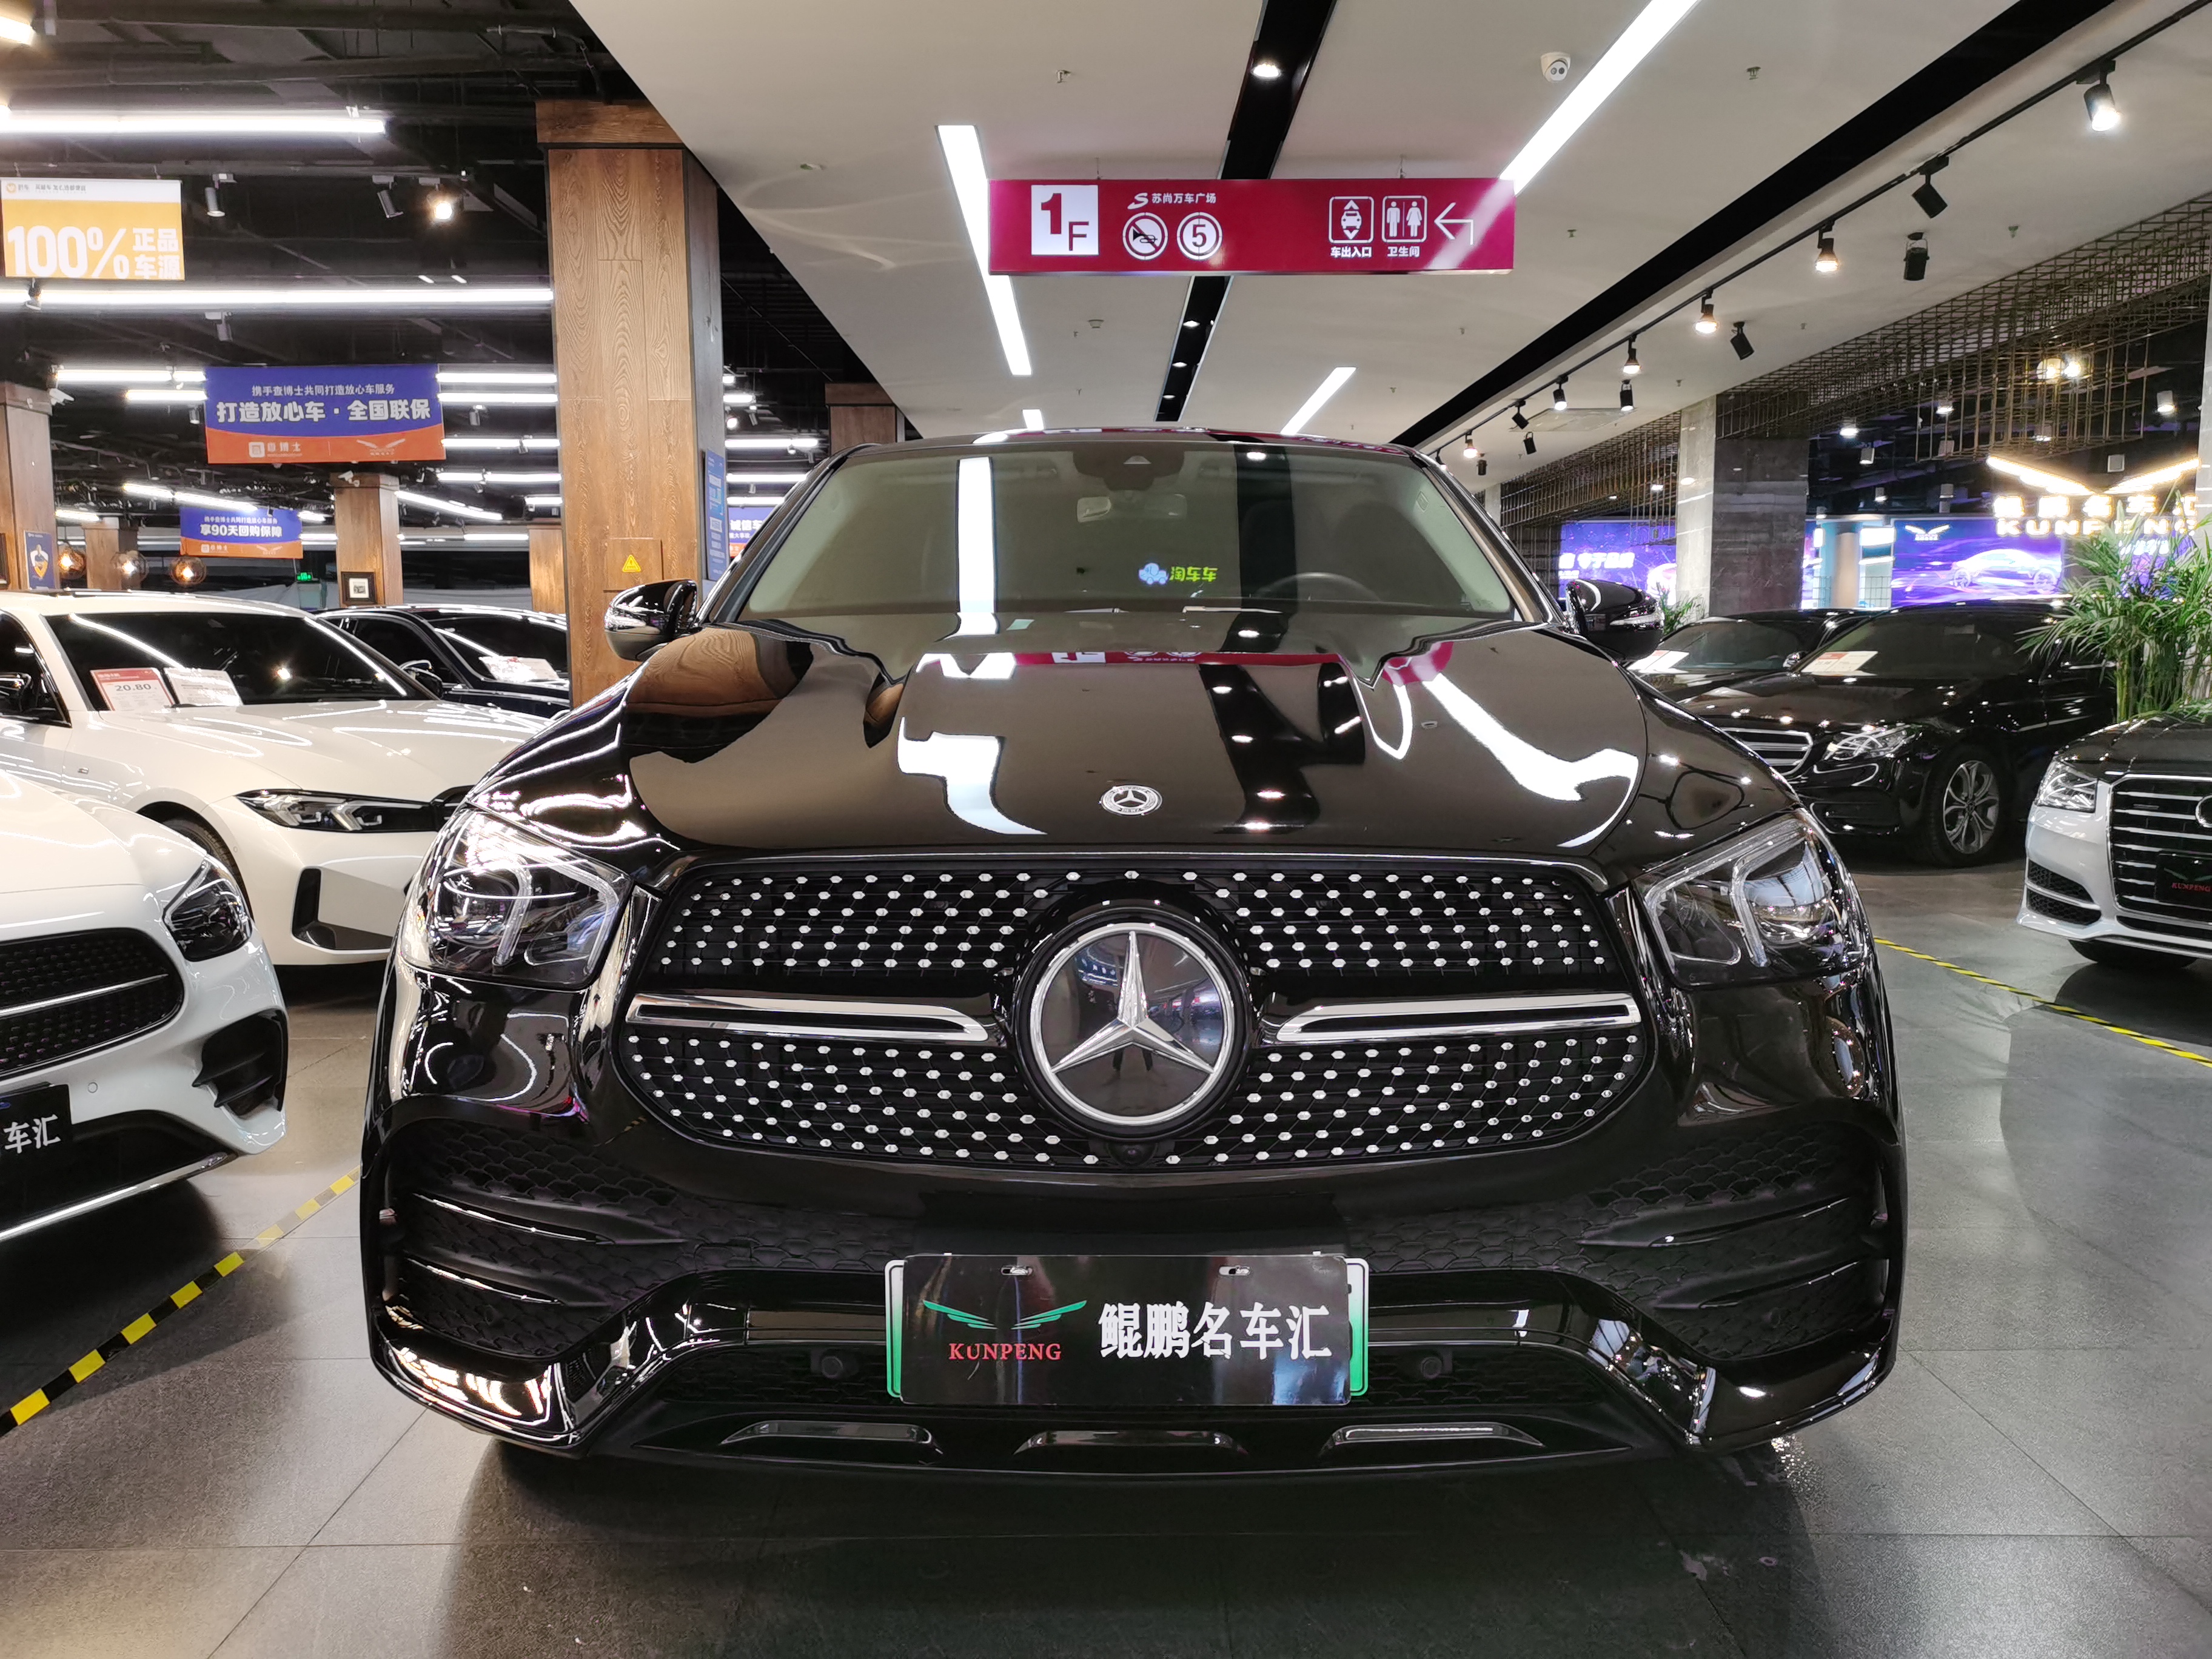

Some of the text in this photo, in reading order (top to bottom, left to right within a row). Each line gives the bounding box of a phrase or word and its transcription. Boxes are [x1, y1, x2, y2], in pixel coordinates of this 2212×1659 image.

[1151, 192, 1216, 204] 苏尚万车广场
[132, 227, 179, 252] 正品
[1192, 224, 1207, 248] 5
[7, 225, 130, 280] 100%
[1330, 246, 1372, 258] 车出入口
[1387, 246, 1421, 258] 卫生间
[135, 254, 181, 280] 车源
[252, 384, 395, 397] 携手查博士共同打造放心车服务
[1994, 494, 2198, 517] 名车汇
[200, 524, 283, 538] 享90天回购保障
[1169, 566, 1218, 582] 淘车车
[3, 1114, 61, 1153] 车汇
[948, 1301, 1333, 1361] KUNPENG 鲲鹏名车汇
